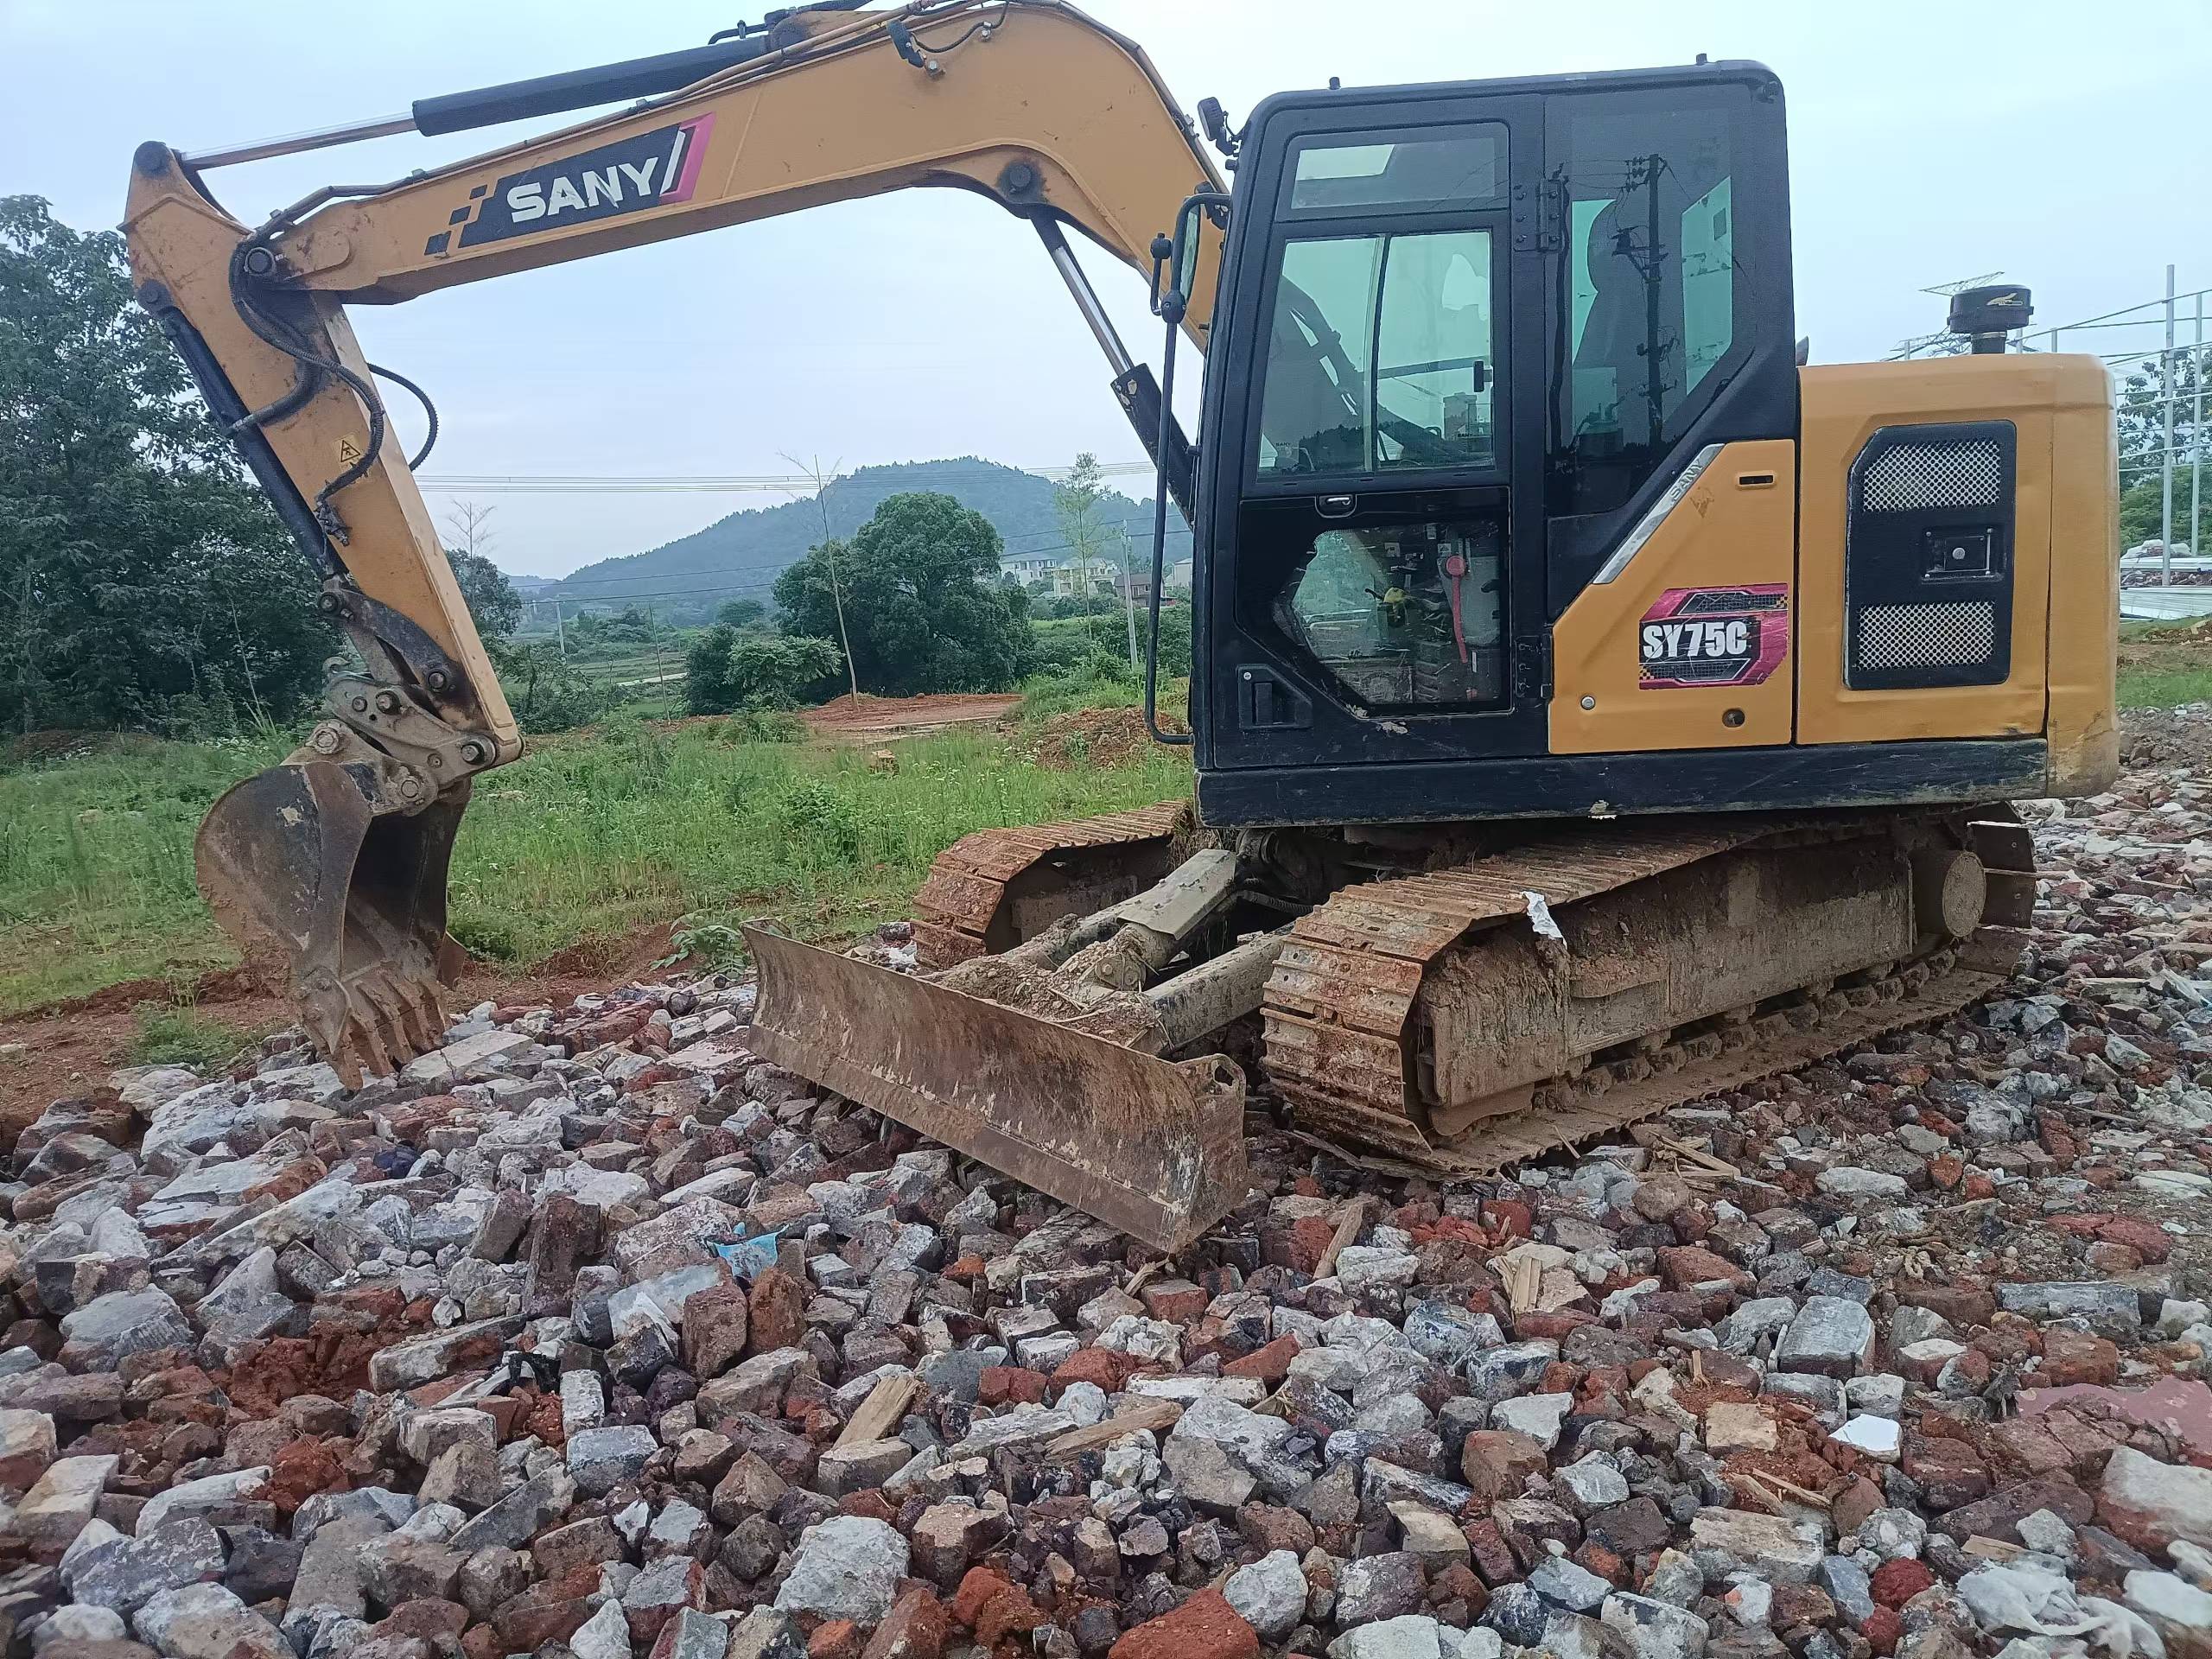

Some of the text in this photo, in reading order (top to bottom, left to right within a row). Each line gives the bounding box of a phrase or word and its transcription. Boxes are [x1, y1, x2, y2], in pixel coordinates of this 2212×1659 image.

[506, 156, 659, 223] SANY
[1669, 458, 1703, 501] SANY
[1643, 620, 1748, 659] SY75C
